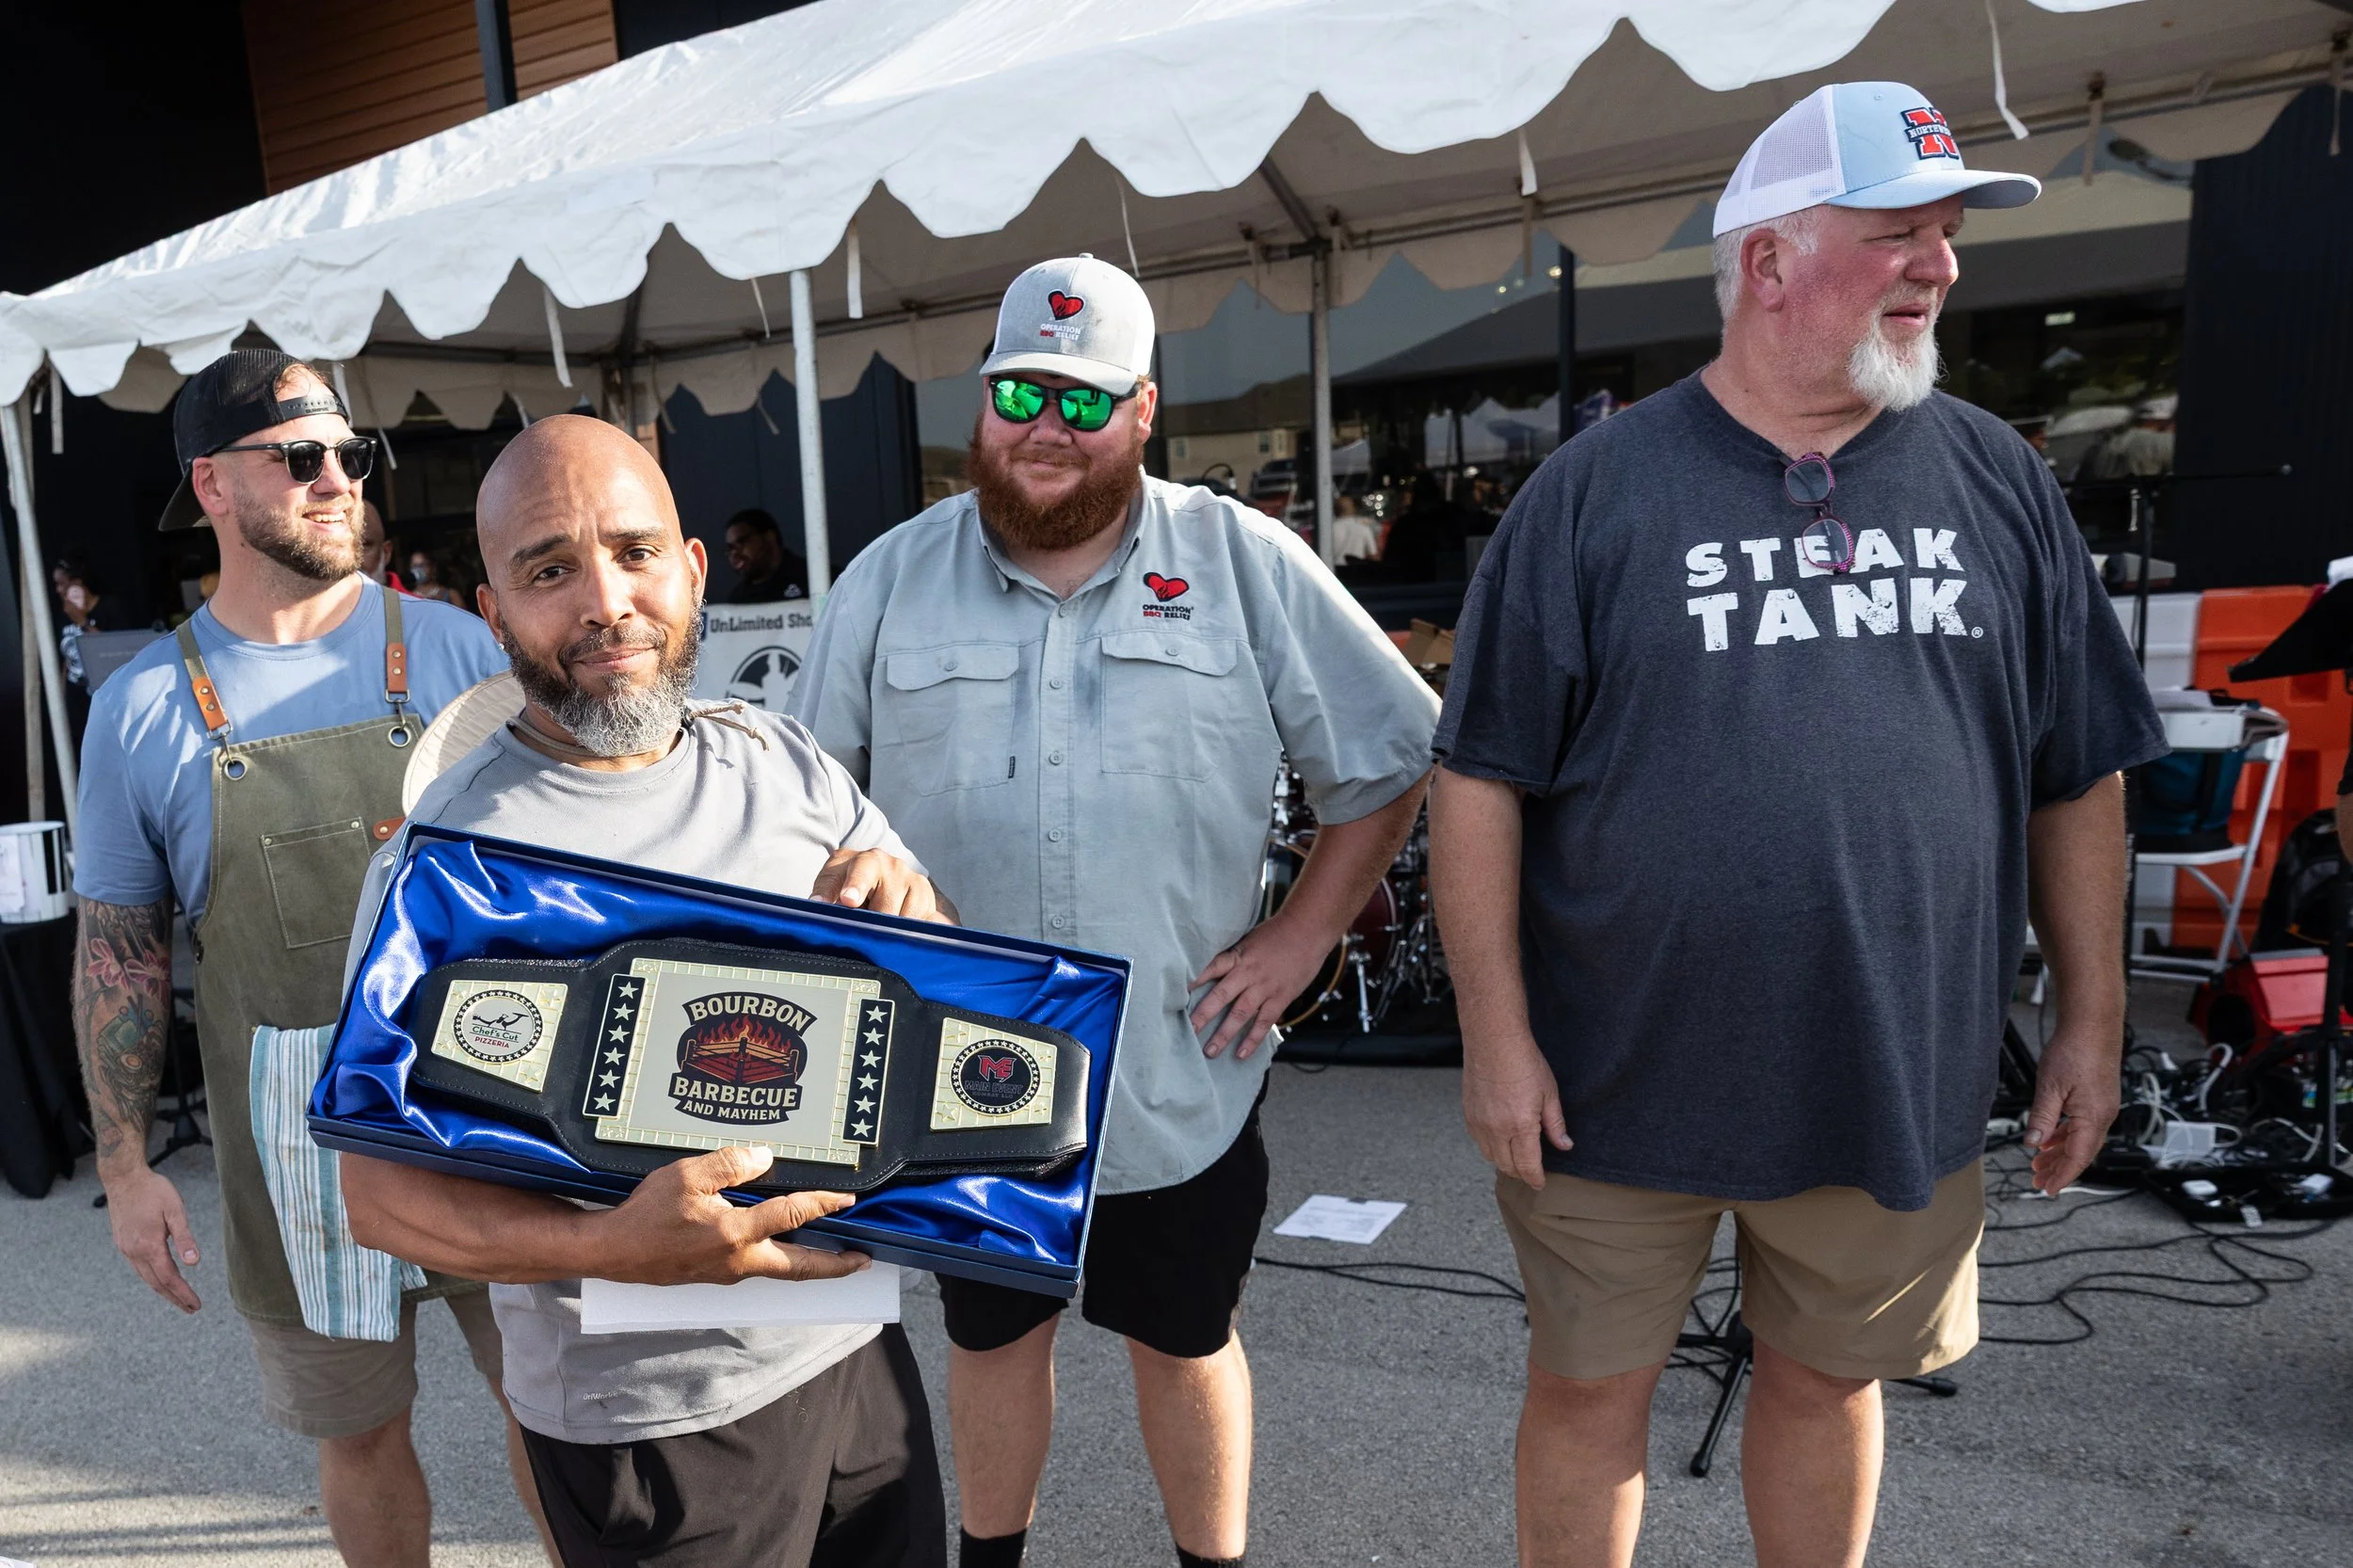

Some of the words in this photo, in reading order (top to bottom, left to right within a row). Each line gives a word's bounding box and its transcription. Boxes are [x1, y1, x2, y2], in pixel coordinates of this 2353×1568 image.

[1040, 323, 1081, 335] OPERATION
[1055, 331, 1080, 341] RELIEF
[1685, 527, 1965, 587] STEAK
[710, 615, 783, 633] UnLimited
[1164, 612, 1191, 621] RELIEF
[689, 995, 811, 1032] BOURBON
[472, 1026, 500, 1036] Chef's
[502, 1032, 519, 1041] Cut
[474, 1036, 509, 1048] PIZZERIA
[673, 1077, 798, 1108] BARBECUE
[964, 1080, 990, 1092] MAIN
[992, 1081, 1024, 1096] EVENT
[682, 1100, 714, 1116] AND
[717, 1108, 780, 1120] MAYHEM
